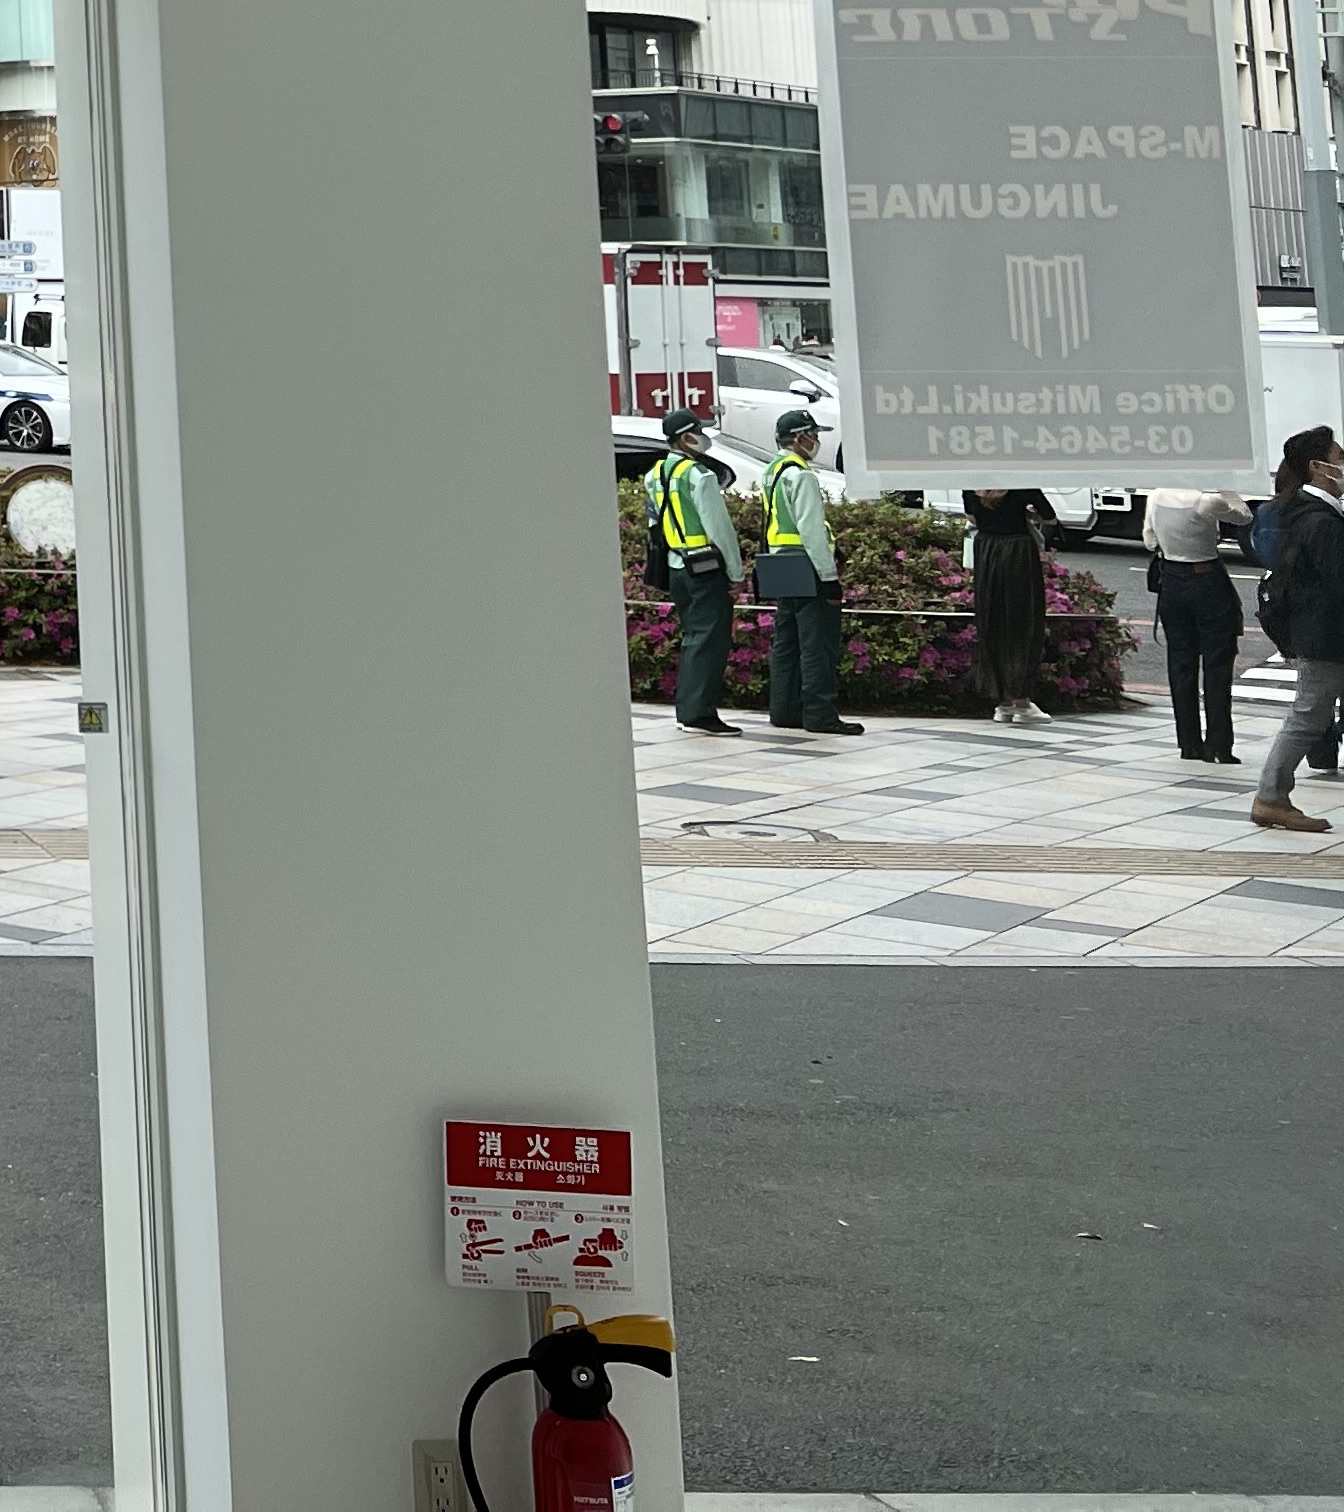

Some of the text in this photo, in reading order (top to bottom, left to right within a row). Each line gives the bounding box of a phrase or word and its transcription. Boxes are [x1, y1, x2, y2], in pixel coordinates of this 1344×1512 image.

[478, 1131, 599, 1162] 消火器
[478, 1156, 600, 1174] FIRE EXTINGUISHER
